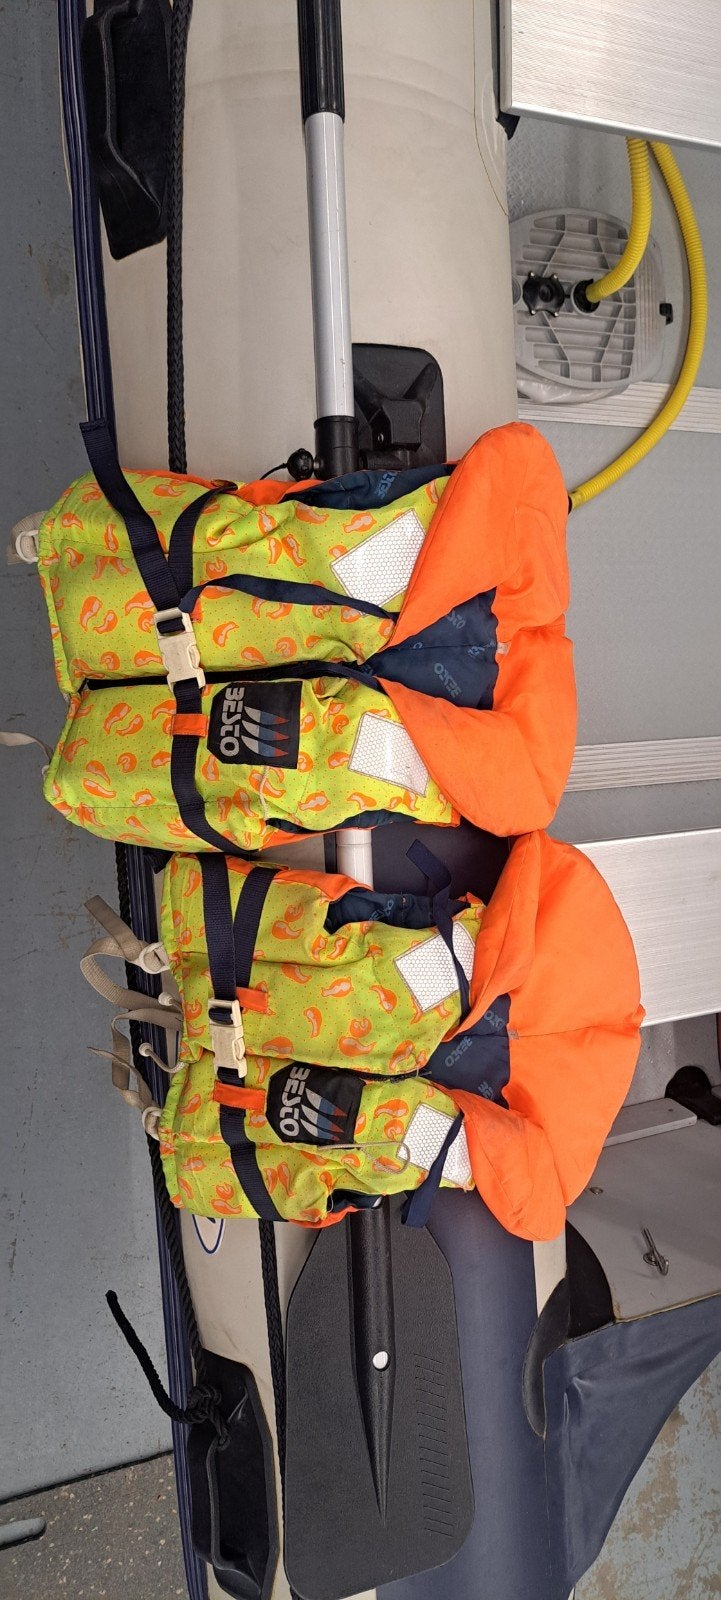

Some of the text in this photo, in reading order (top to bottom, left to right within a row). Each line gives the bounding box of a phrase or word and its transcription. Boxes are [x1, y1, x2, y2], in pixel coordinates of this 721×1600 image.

[433, 662, 463, 698] BESTO
[219, 686, 246, 757] BESTO
[444, 1036, 473, 1068] BESTO
[279, 1066, 311, 1137] BESTO
